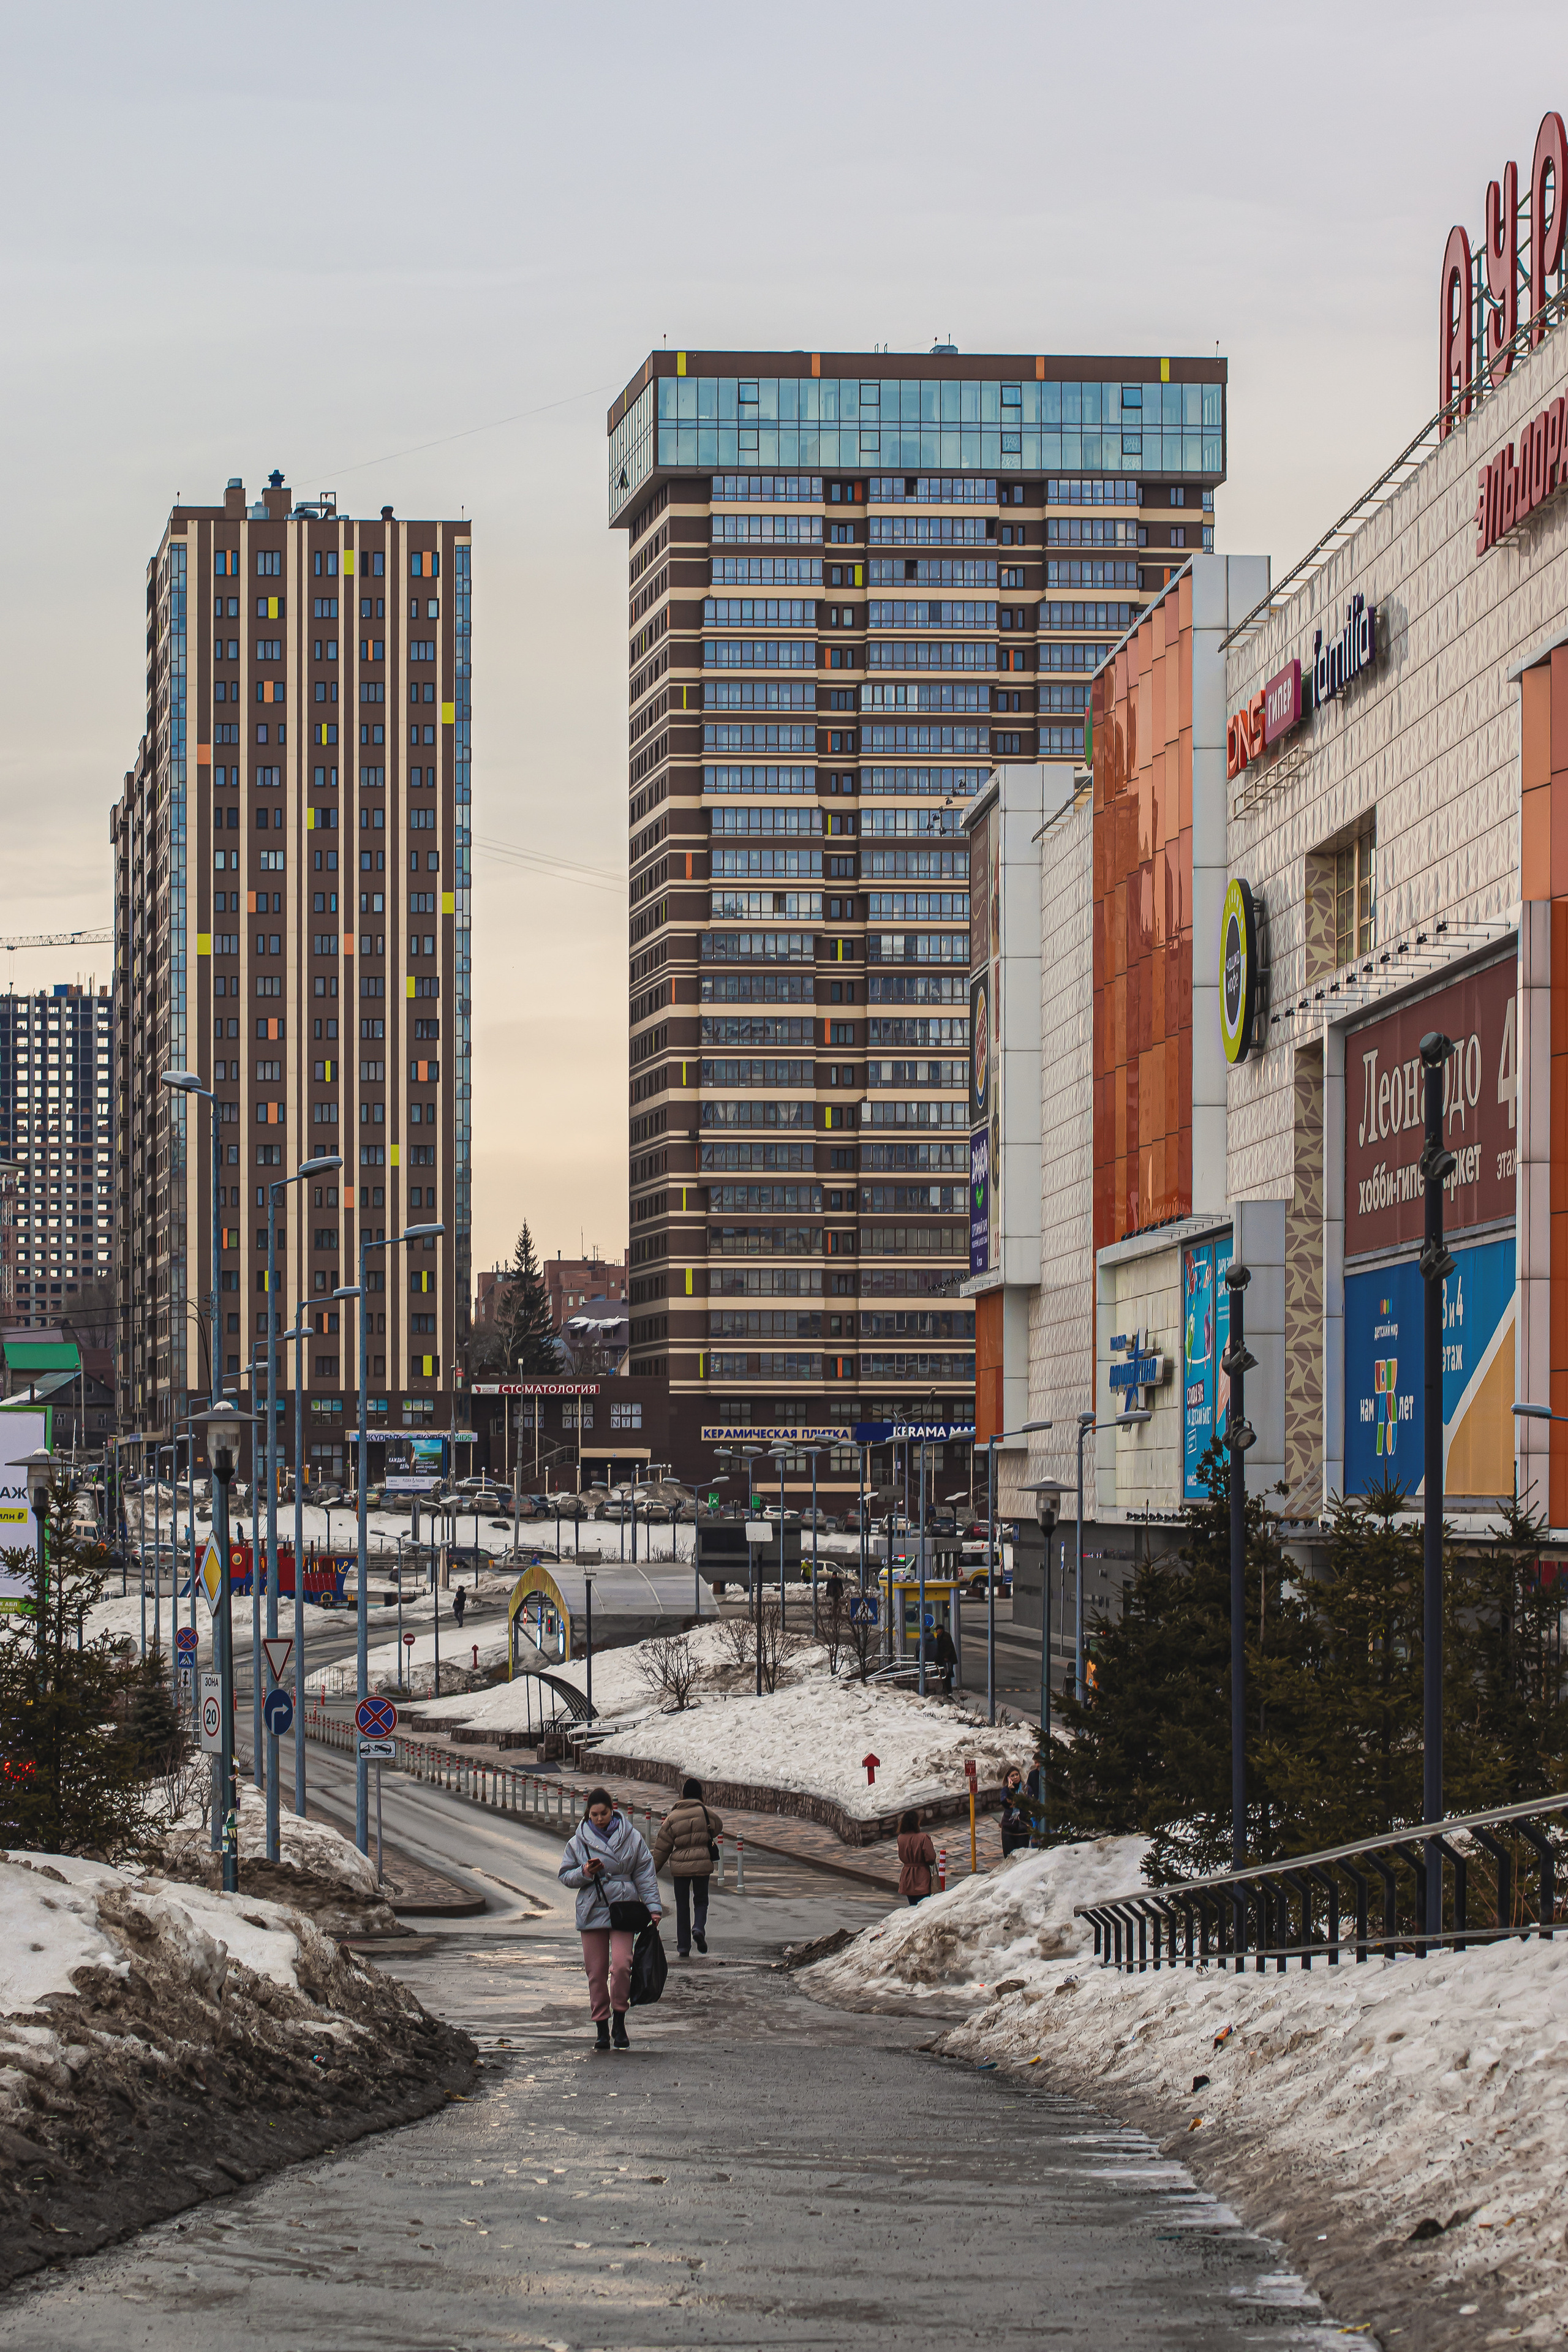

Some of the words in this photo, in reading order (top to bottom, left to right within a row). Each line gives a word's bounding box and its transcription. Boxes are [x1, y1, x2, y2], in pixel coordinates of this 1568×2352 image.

[1313, 592, 1375, 709] familia
[1268, 677, 1292, 728] ГИПЕР
[1227, 690, 1267, 780] DNS
[1497, 996, 1517, 1129] 4
[1359, 1033, 1482, 1148] Леондо
[1449, 1302, 1455, 1328] и
[1456, 1275, 1463, 1326] 4
[1374, 1320, 1390, 1341] детский
[502, 1384, 596, 1394] СТОМАТОЛОГИЯ
[1360, 1398, 1374, 1422] нам
[1398, 1395, 1414, 1421] лет
[704, 1429, 797, 1439] КЕРАМИЧЕСКАЯ
[205, 1677, 219, 1687] ЗОНА
[206, 1708, 216, 1725] 20
